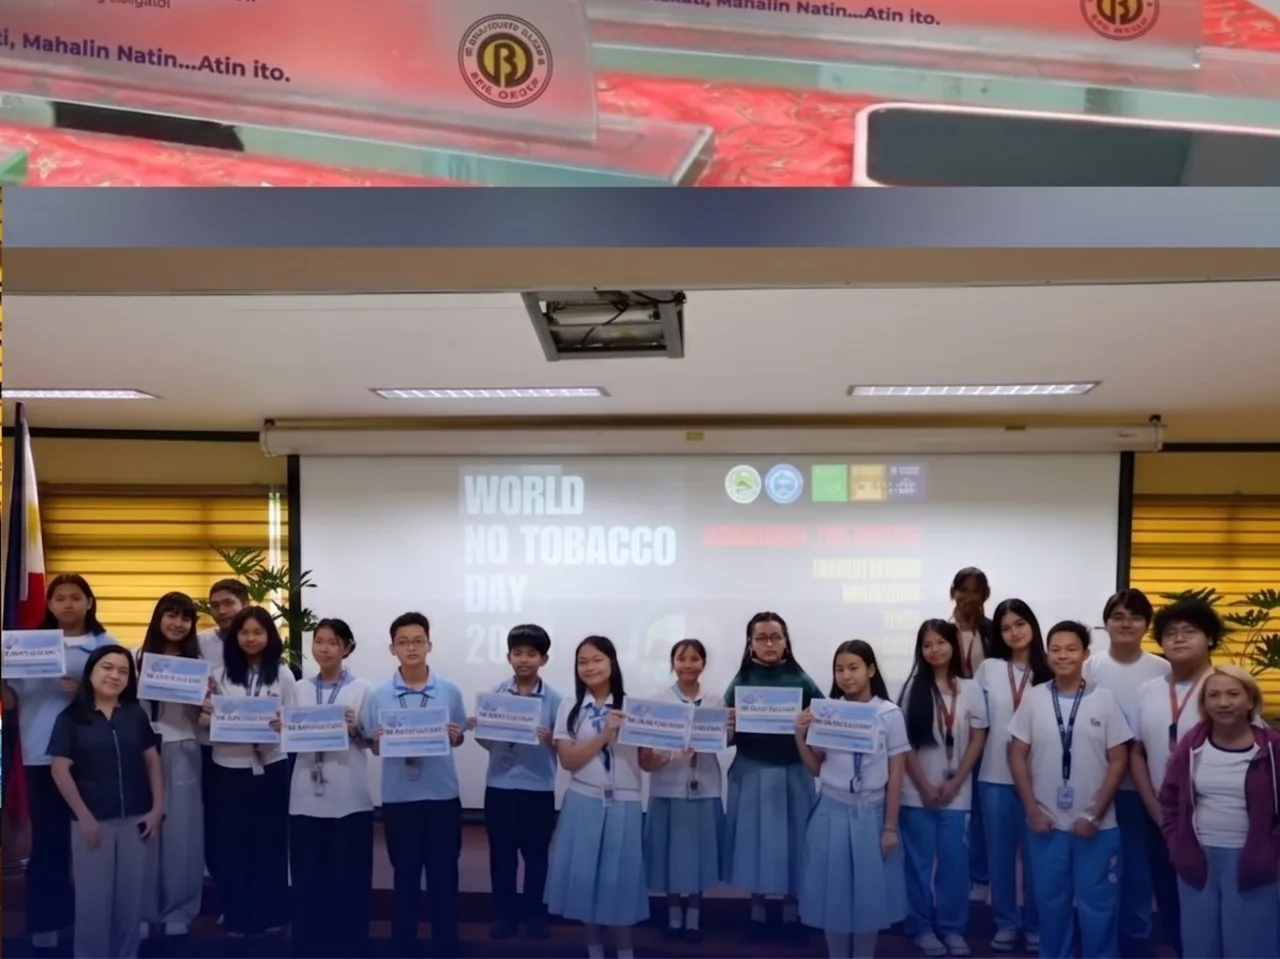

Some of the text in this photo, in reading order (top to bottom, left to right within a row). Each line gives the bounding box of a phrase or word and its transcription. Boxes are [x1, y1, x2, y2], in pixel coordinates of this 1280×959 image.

[908, 9, 941, 26] ito.
[22, 32, 110, 60] Mahalin
[253, 59, 291, 82] ito.
[464, 475, 584, 515] WORLD
[464, 524, 508, 564] NO
[521, 525, 676, 566] TOBACCO
[465, 574, 527, 613] DAY
